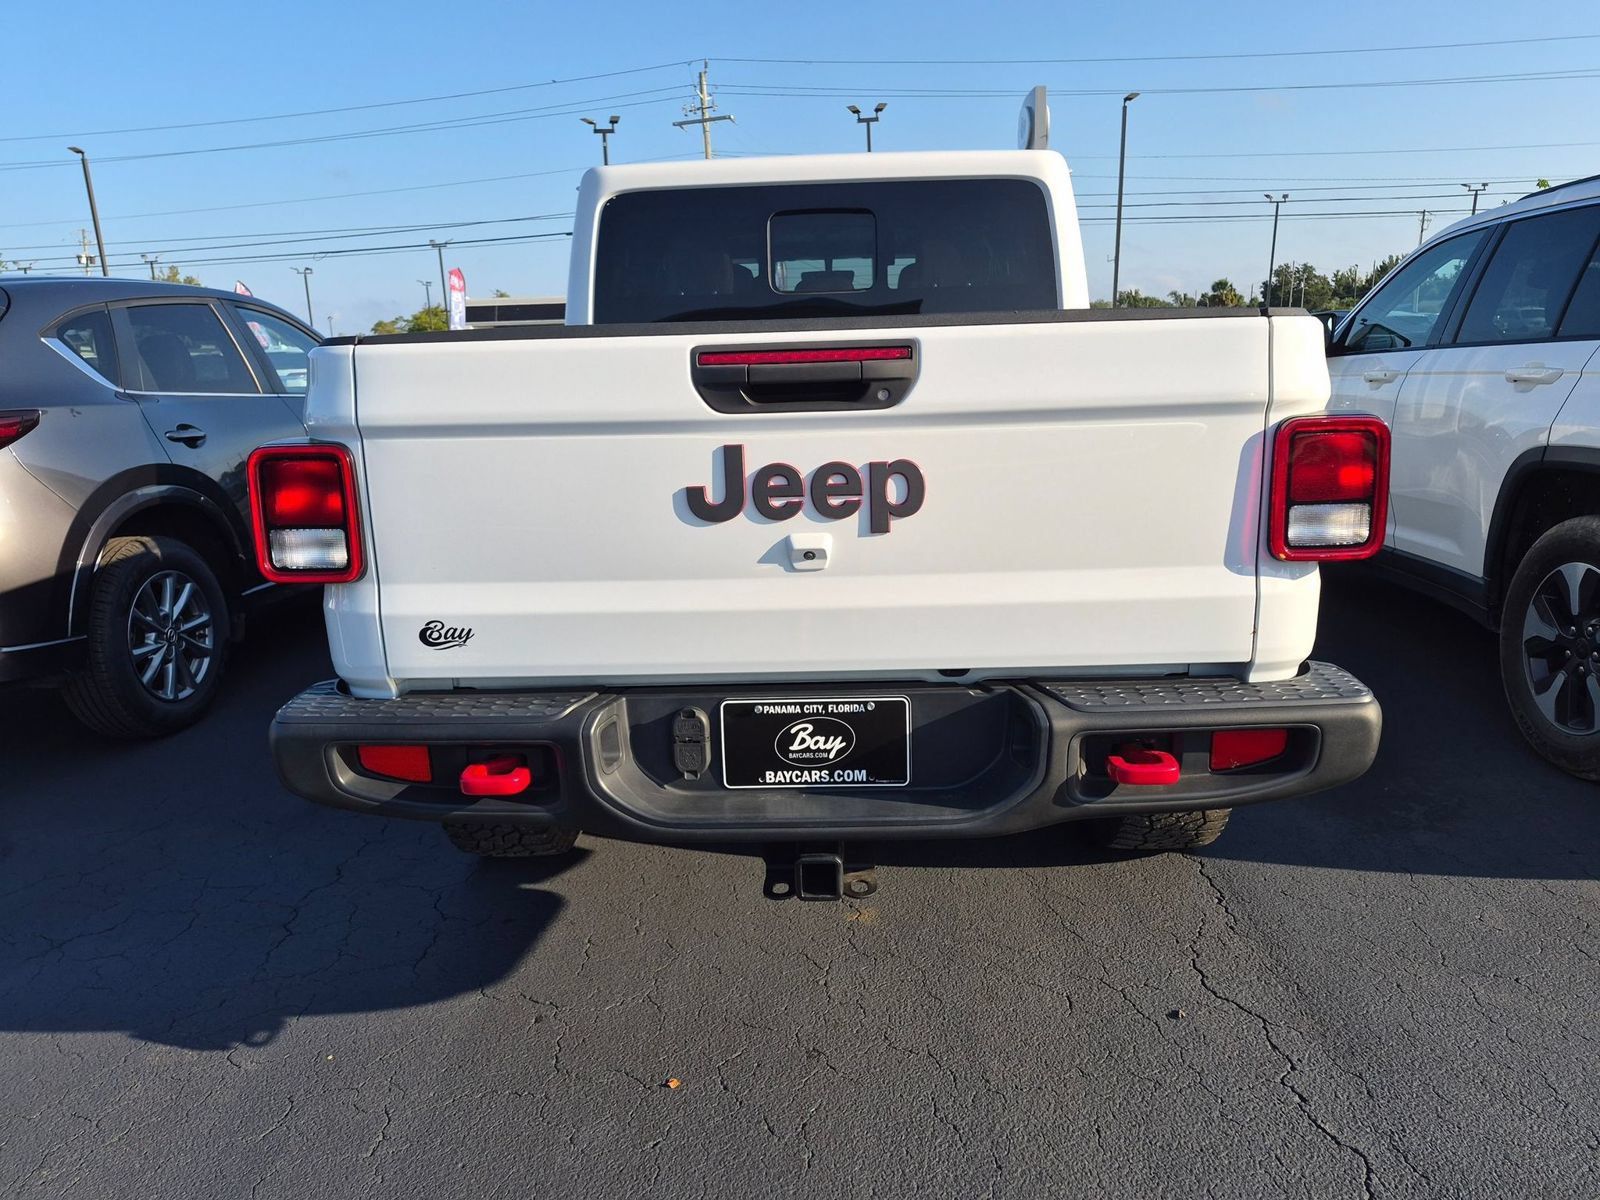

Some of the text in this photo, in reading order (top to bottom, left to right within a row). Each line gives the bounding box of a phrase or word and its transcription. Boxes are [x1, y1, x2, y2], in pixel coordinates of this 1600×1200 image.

[686, 443, 926, 533] Jeep
[419, 620, 475, 649] Bay
[763, 703, 866, 715] PANAMA CITY, FLORIDA
[789, 723, 846, 759] Bay
[765, 769, 867, 783] BAYCARS.COM
